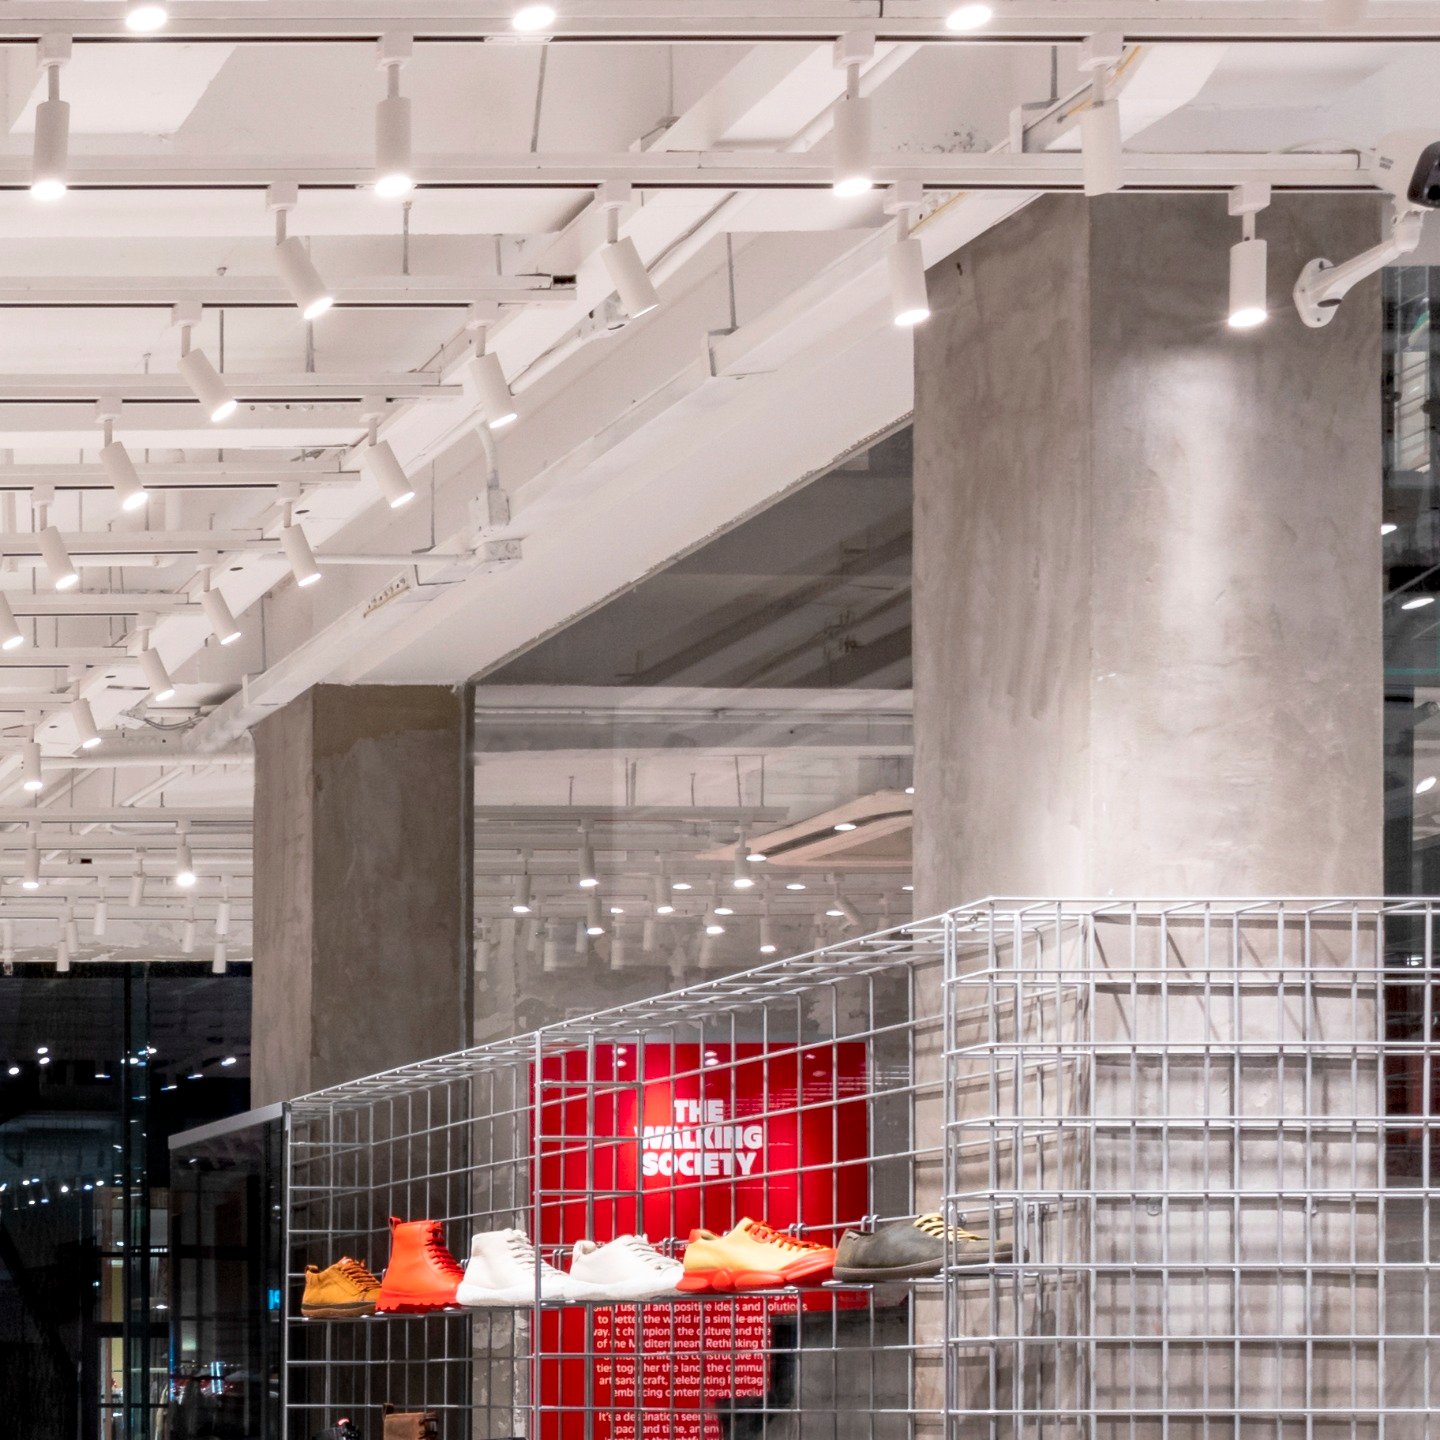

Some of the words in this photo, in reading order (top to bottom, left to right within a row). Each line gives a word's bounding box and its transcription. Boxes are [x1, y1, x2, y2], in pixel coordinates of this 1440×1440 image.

[673, 1099, 723, 1122] THE
[634, 1126, 762, 1149] WALKING
[642, 1152, 756, 1176] SOCIETY
[742, 1301, 760, 1311] and
[598, 1315, 609, 1324] to
[644, 1314, 660, 1324] the
[705, 1315, 711, 1323] a
[678, 1326, 694, 1336] the
[597, 1339, 608, 1348] of
[662, 1363, 679, 1373] the
[707, 1363, 724, 1373] the
[643, 1375, 668, 1386] craft,
[642, 1425, 660, 1434] and
